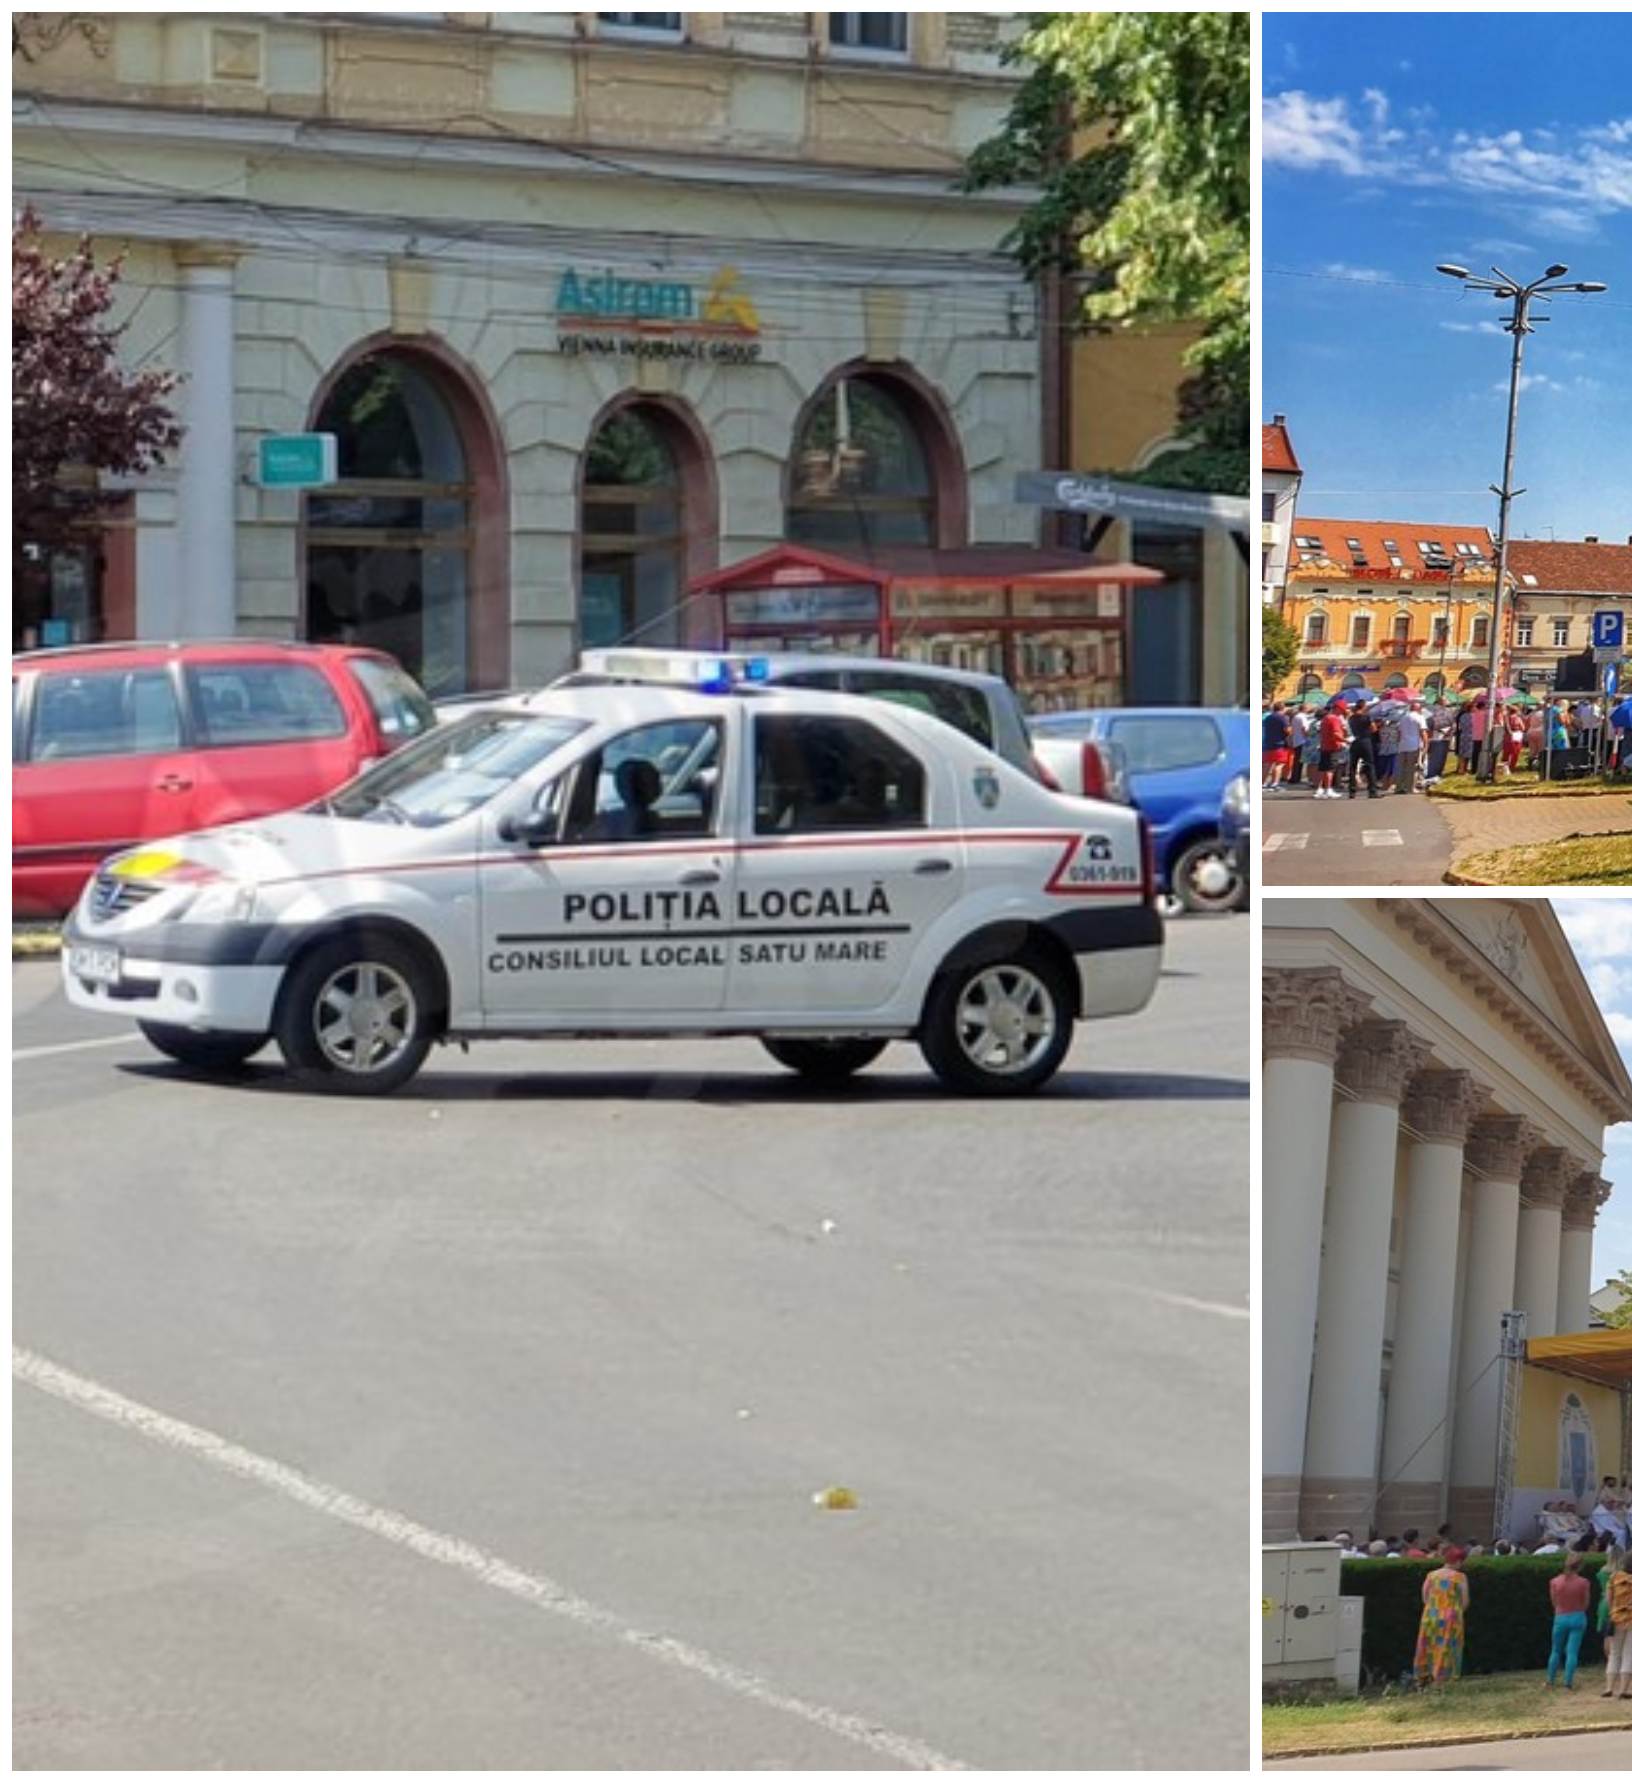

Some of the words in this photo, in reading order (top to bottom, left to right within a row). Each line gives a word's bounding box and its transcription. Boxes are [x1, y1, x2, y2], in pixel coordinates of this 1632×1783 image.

[557, 266, 692, 318] Asirom
[556, 335, 616, 356] VIENNA
[620, 339, 704, 360] INSURANCE
[710, 343, 762, 363] GROUP
[1600, 614, 1619, 640] P
[563, 890, 721, 929] POLIȚIA
[737, 881, 891, 919] LOCALĂ
[488, 948, 632, 974] CONSILIUL
[640, 946, 724, 967] LOCAL
[738, 942, 807, 964] SATU
[814, 940, 888, 962] MARE
